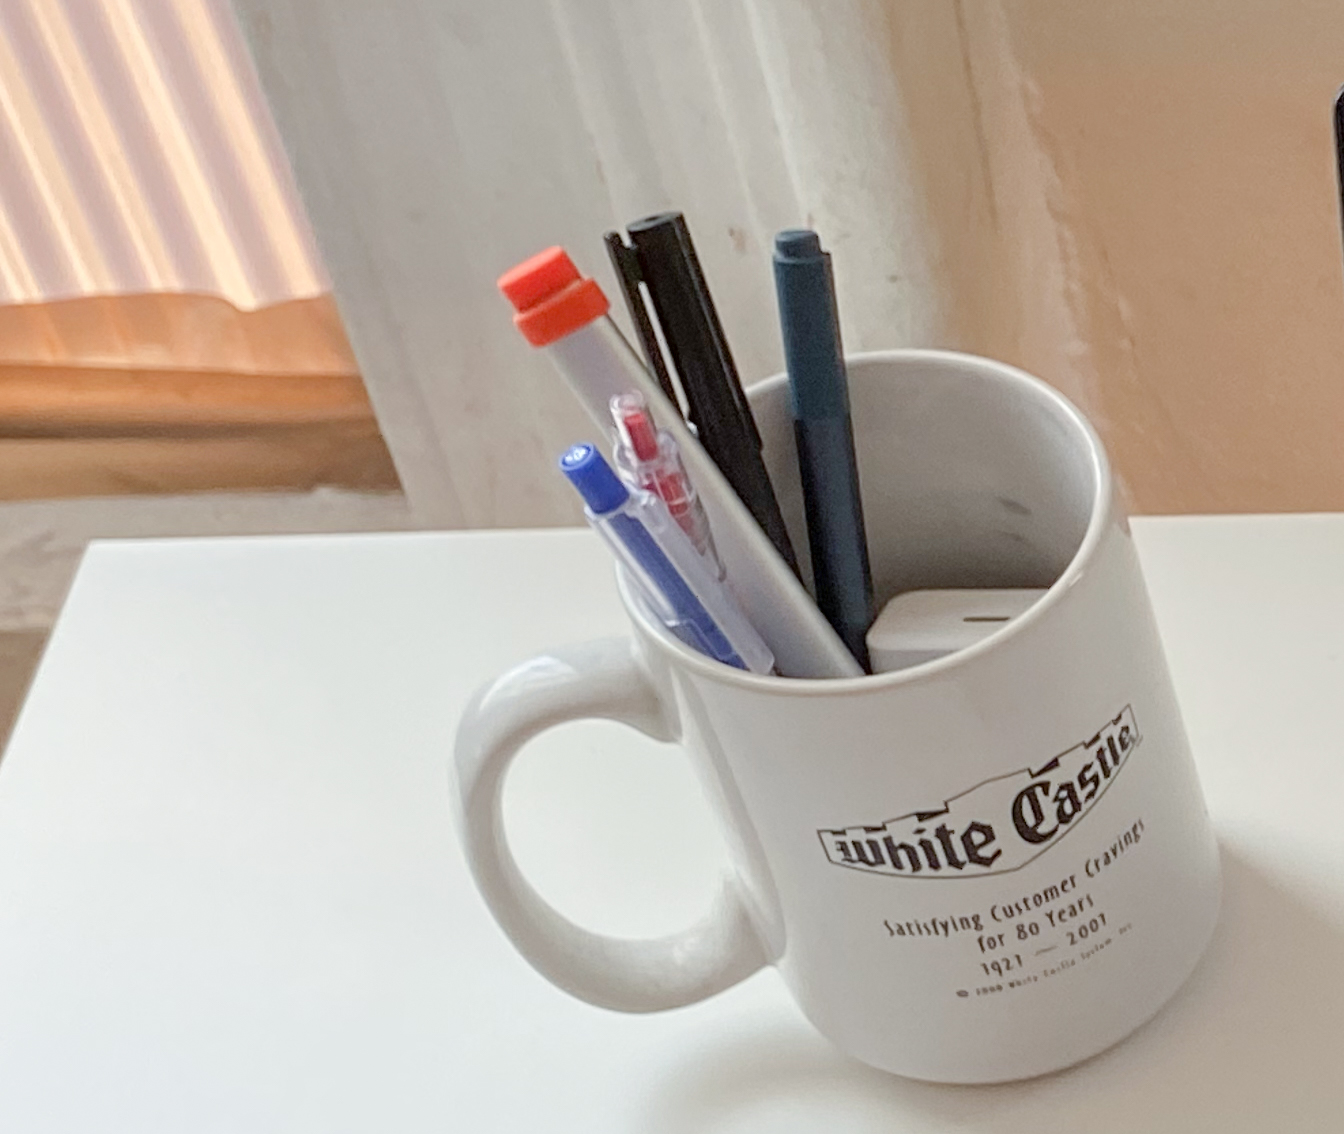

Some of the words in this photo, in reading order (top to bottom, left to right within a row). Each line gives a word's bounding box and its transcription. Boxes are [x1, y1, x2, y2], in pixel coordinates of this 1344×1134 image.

[1011, 724, 1131, 844] Castle
[884, 912, 984, 937] Satisfying
[991, 874, 1076, 923] Customer
[1085, 818, 1144, 878] Cravings
[977, 933, 1006, 953] for
[1017, 920, 1040, 940] 80
[1045, 894, 1094, 927] Years
[981, 954, 1023, 976] 1921
[1067, 914, 1107, 945] 2001
